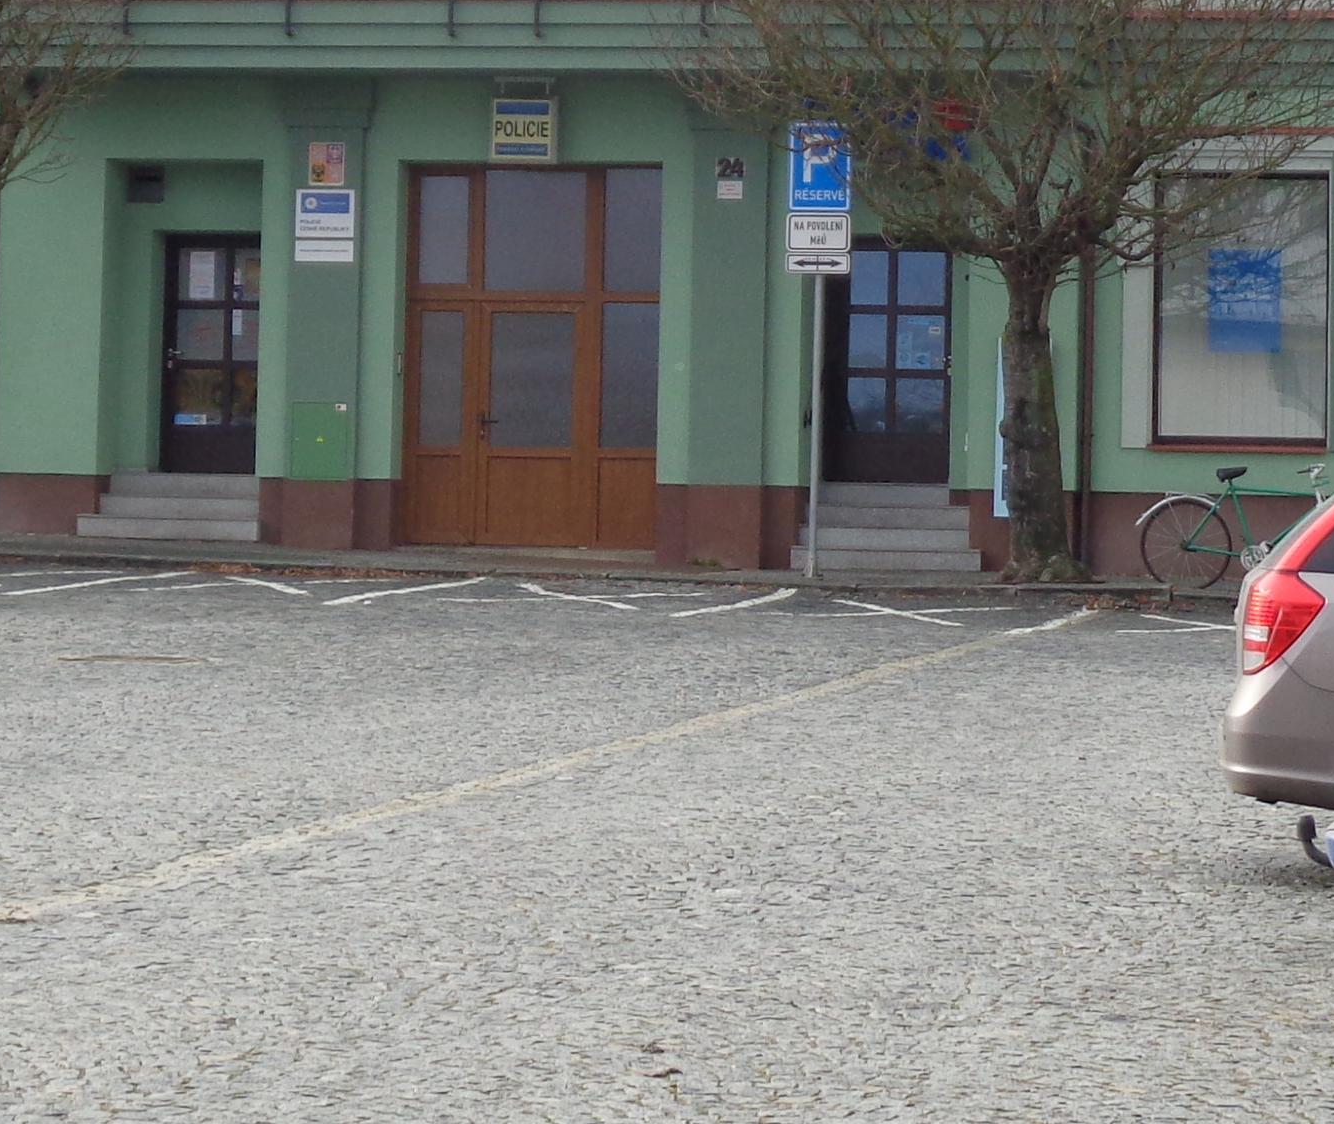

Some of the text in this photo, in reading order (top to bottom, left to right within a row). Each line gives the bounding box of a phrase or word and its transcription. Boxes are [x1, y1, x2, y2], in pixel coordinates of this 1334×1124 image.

[495, 120, 549, 138] POLICIE
[717, 157, 744, 178] 24
[802, 133, 837, 184] P
[794, 188, 846, 202] RÉSERVÉ
[794, 219, 844, 231] NA POVOLENÍ
